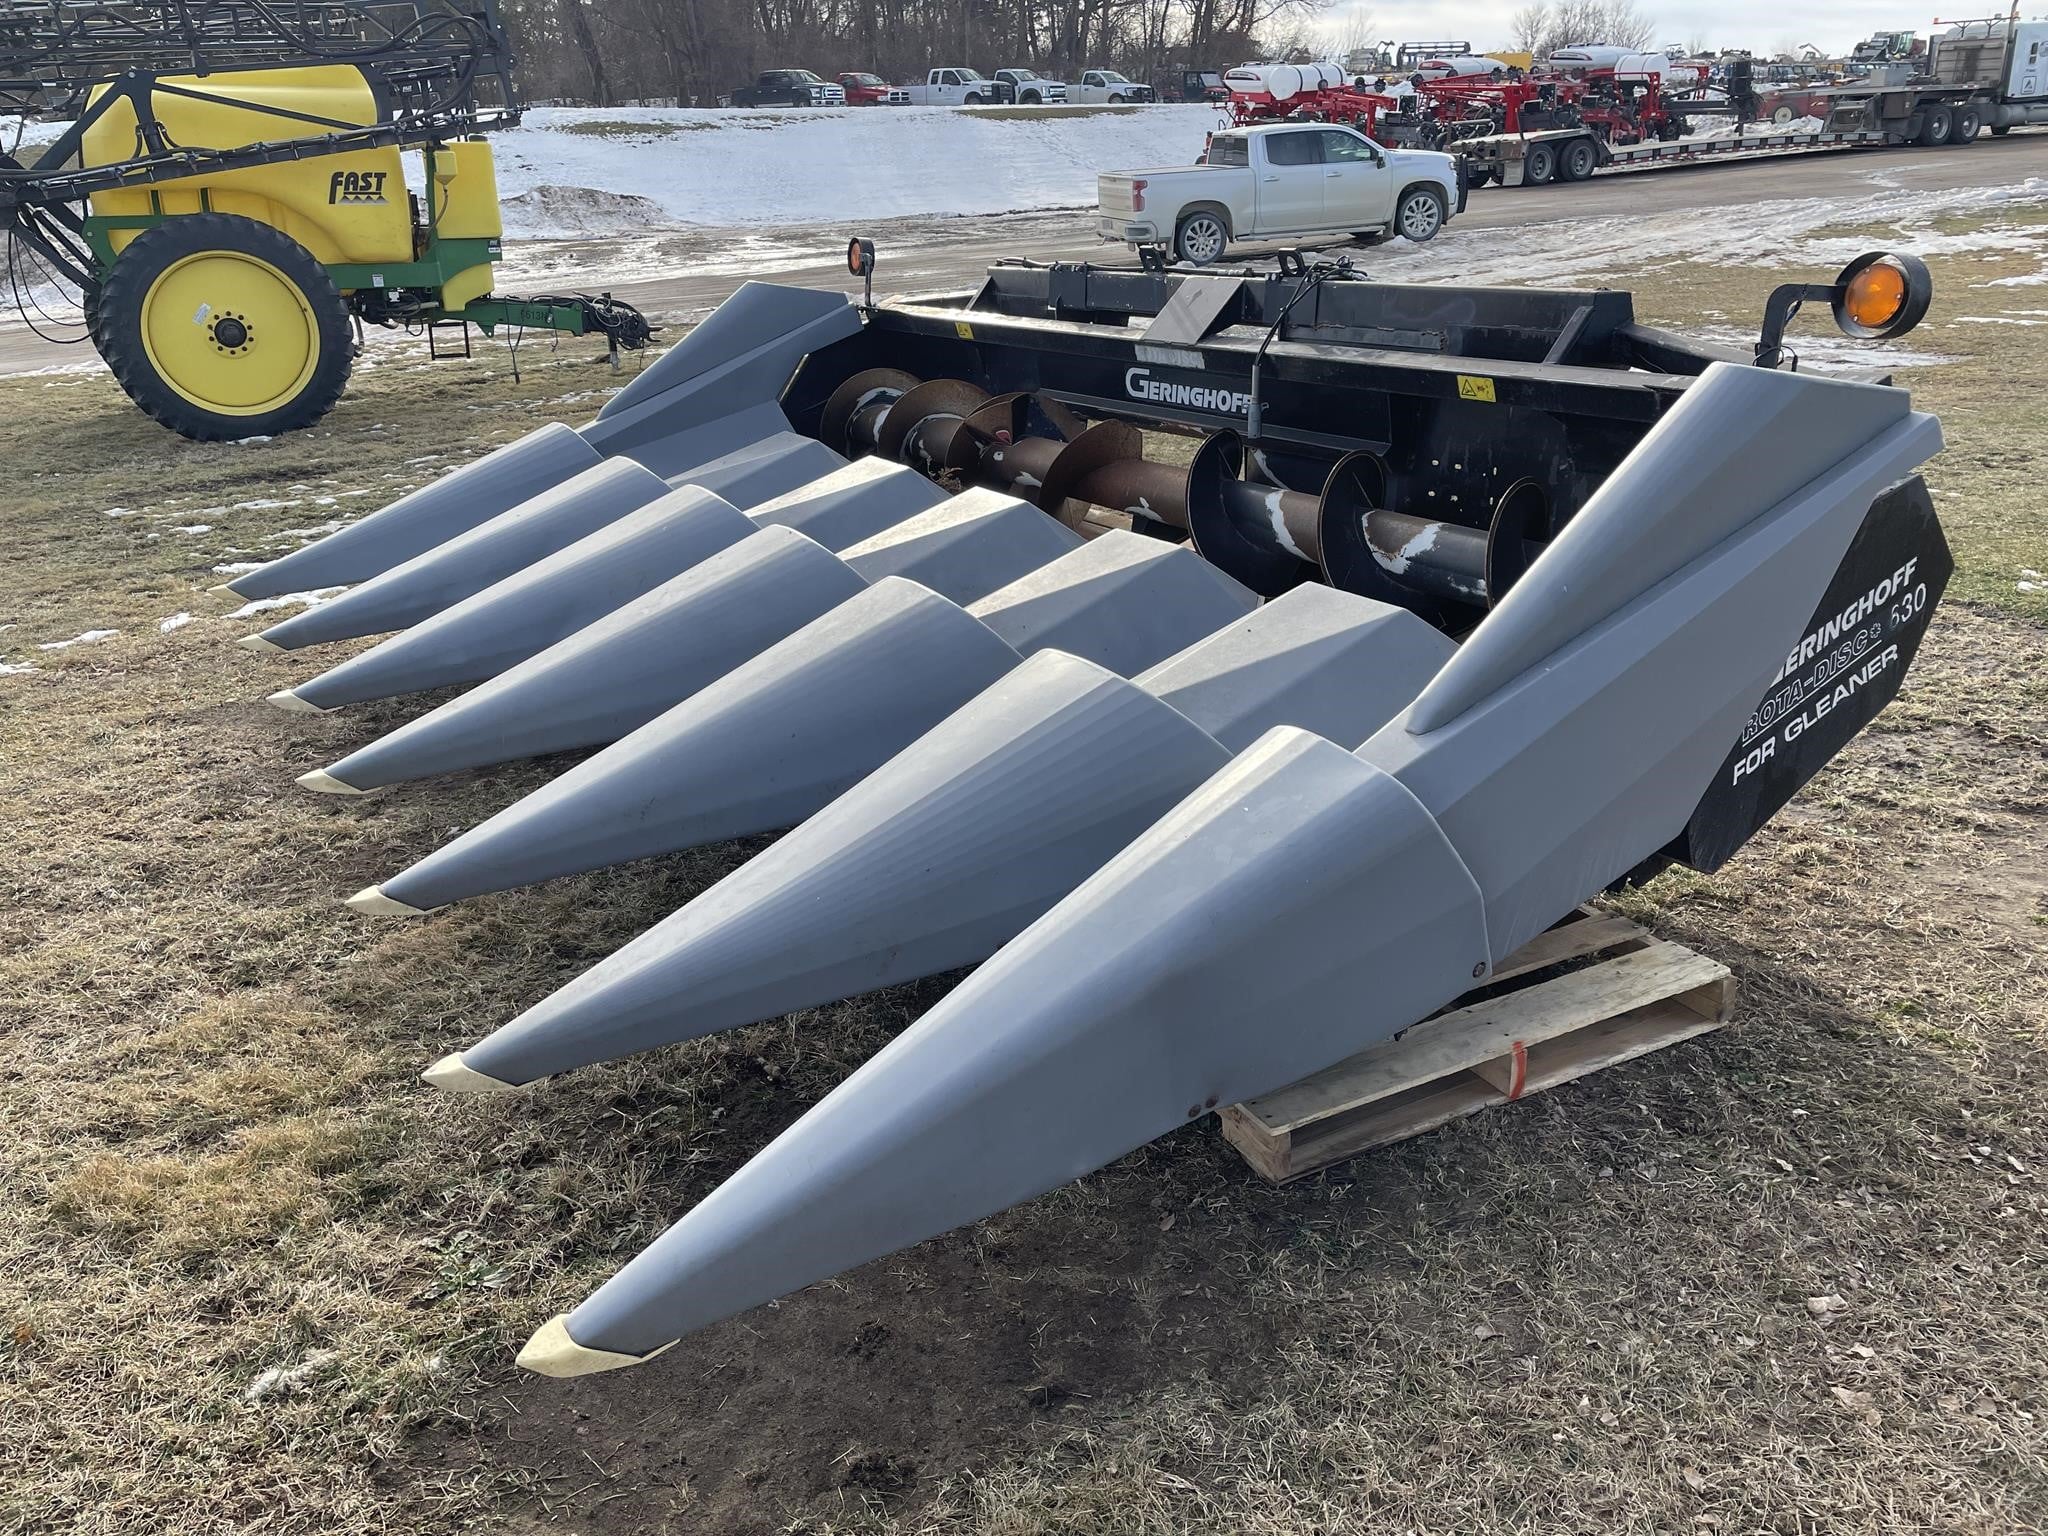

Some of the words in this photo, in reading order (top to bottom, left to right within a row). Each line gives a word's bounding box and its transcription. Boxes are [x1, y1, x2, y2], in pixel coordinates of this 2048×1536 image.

[329, 171, 387, 204] FAST
[1768, 556, 1918, 689] ERINGHOFF
[1890, 582, 1927, 630] 630
[1732, 735, 1776, 787] FOR
[1784, 643, 1899, 742] GLEANER
